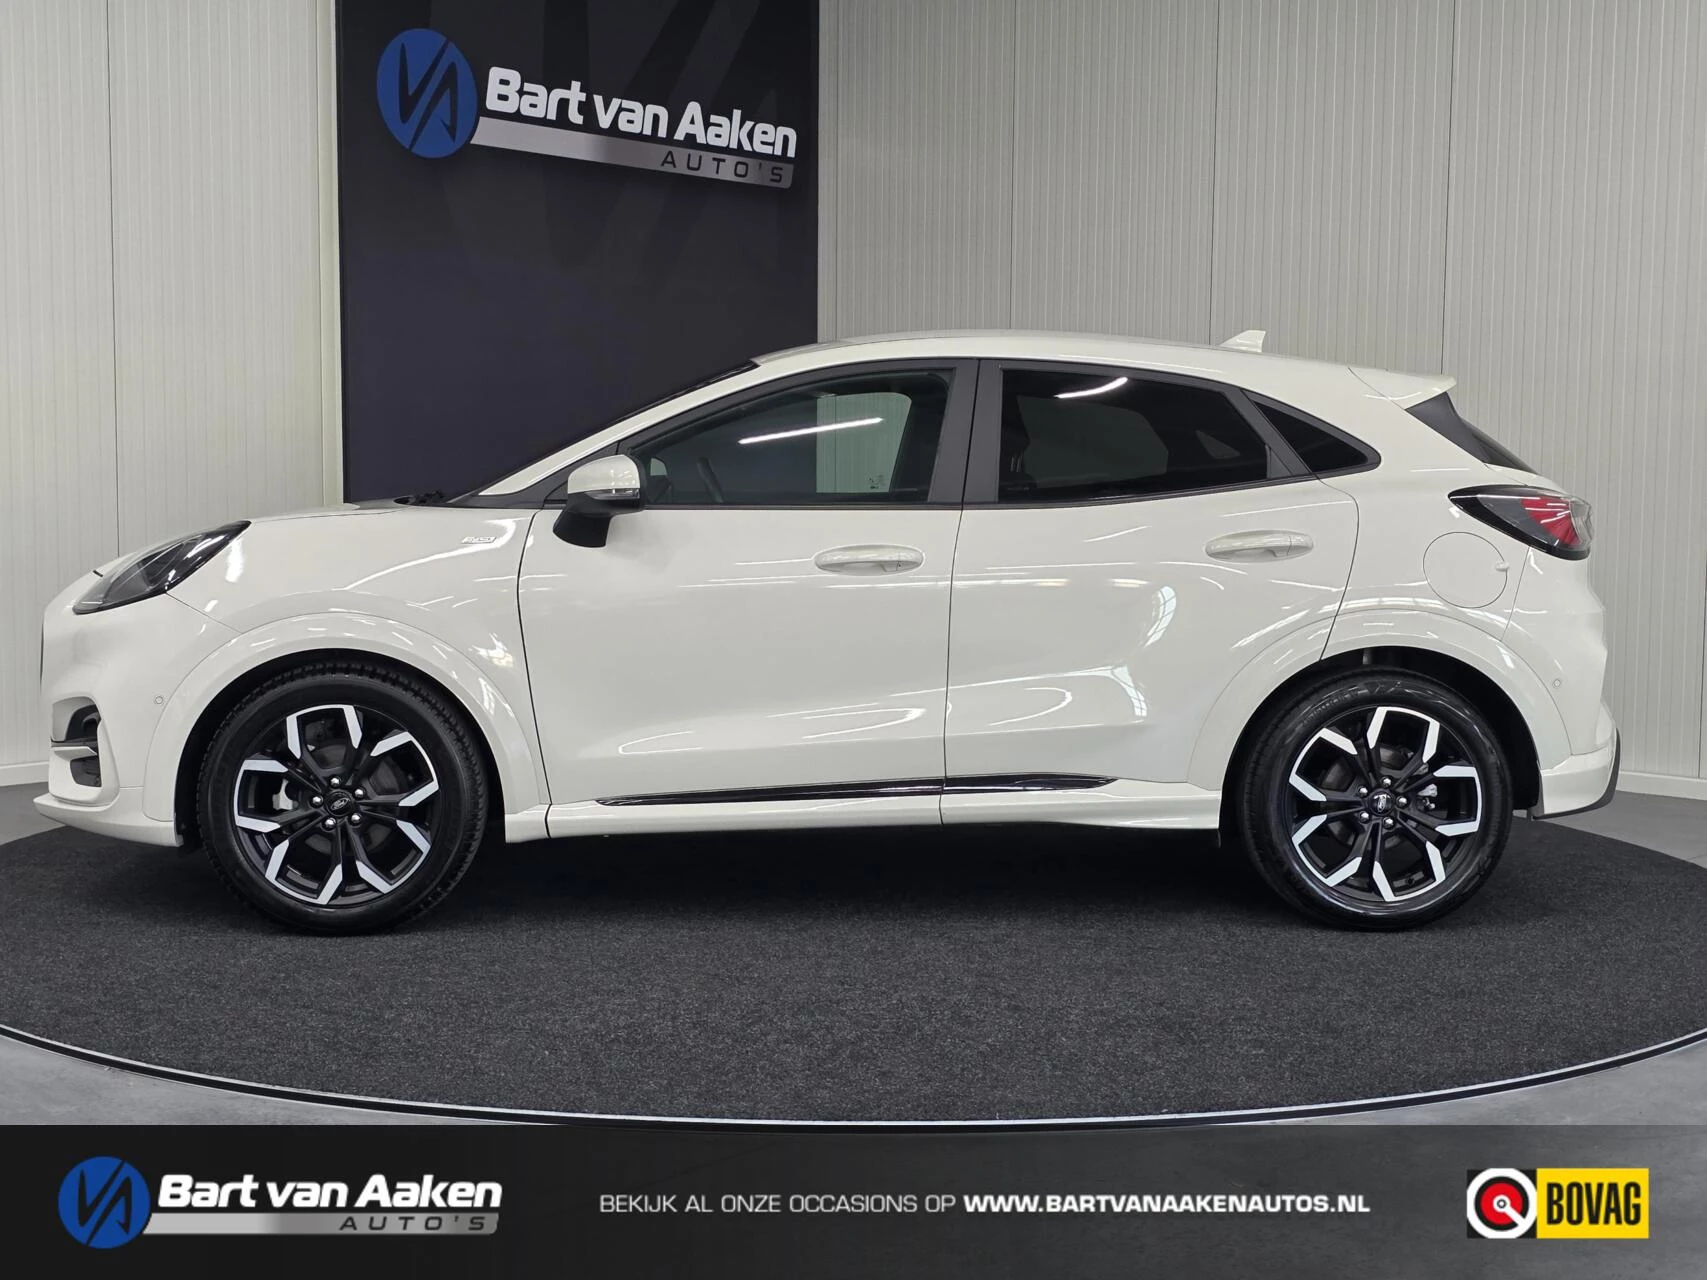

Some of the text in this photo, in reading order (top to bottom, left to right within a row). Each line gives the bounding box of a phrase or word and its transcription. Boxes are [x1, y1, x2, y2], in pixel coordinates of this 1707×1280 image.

[485, 66, 797, 158] Bart van Aaken
[660, 150, 784, 184] AUTO'S
